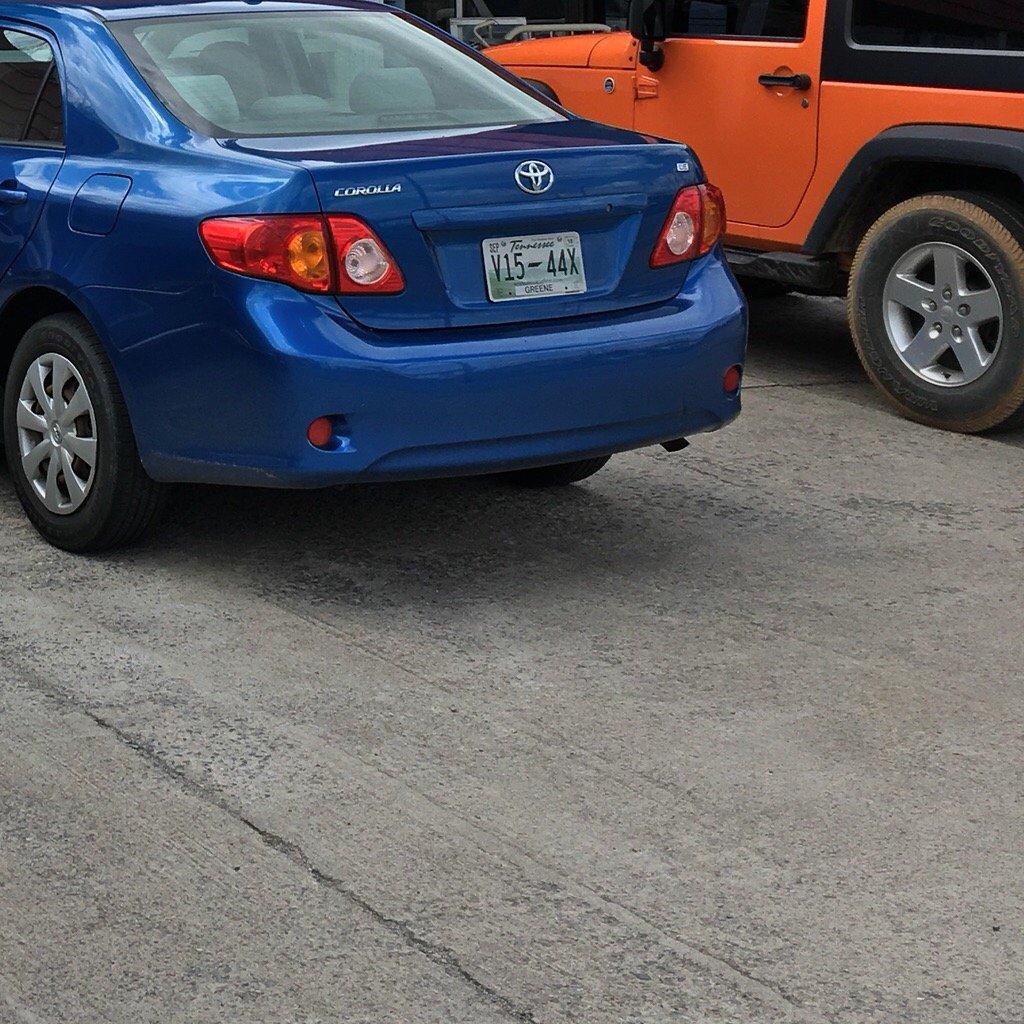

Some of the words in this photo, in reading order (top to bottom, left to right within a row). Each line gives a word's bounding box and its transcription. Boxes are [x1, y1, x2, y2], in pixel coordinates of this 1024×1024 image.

[334, 183, 401, 197] COROLLA
[510, 239, 555, 253] Tennessee
[524, 283, 553, 294] GREENE
